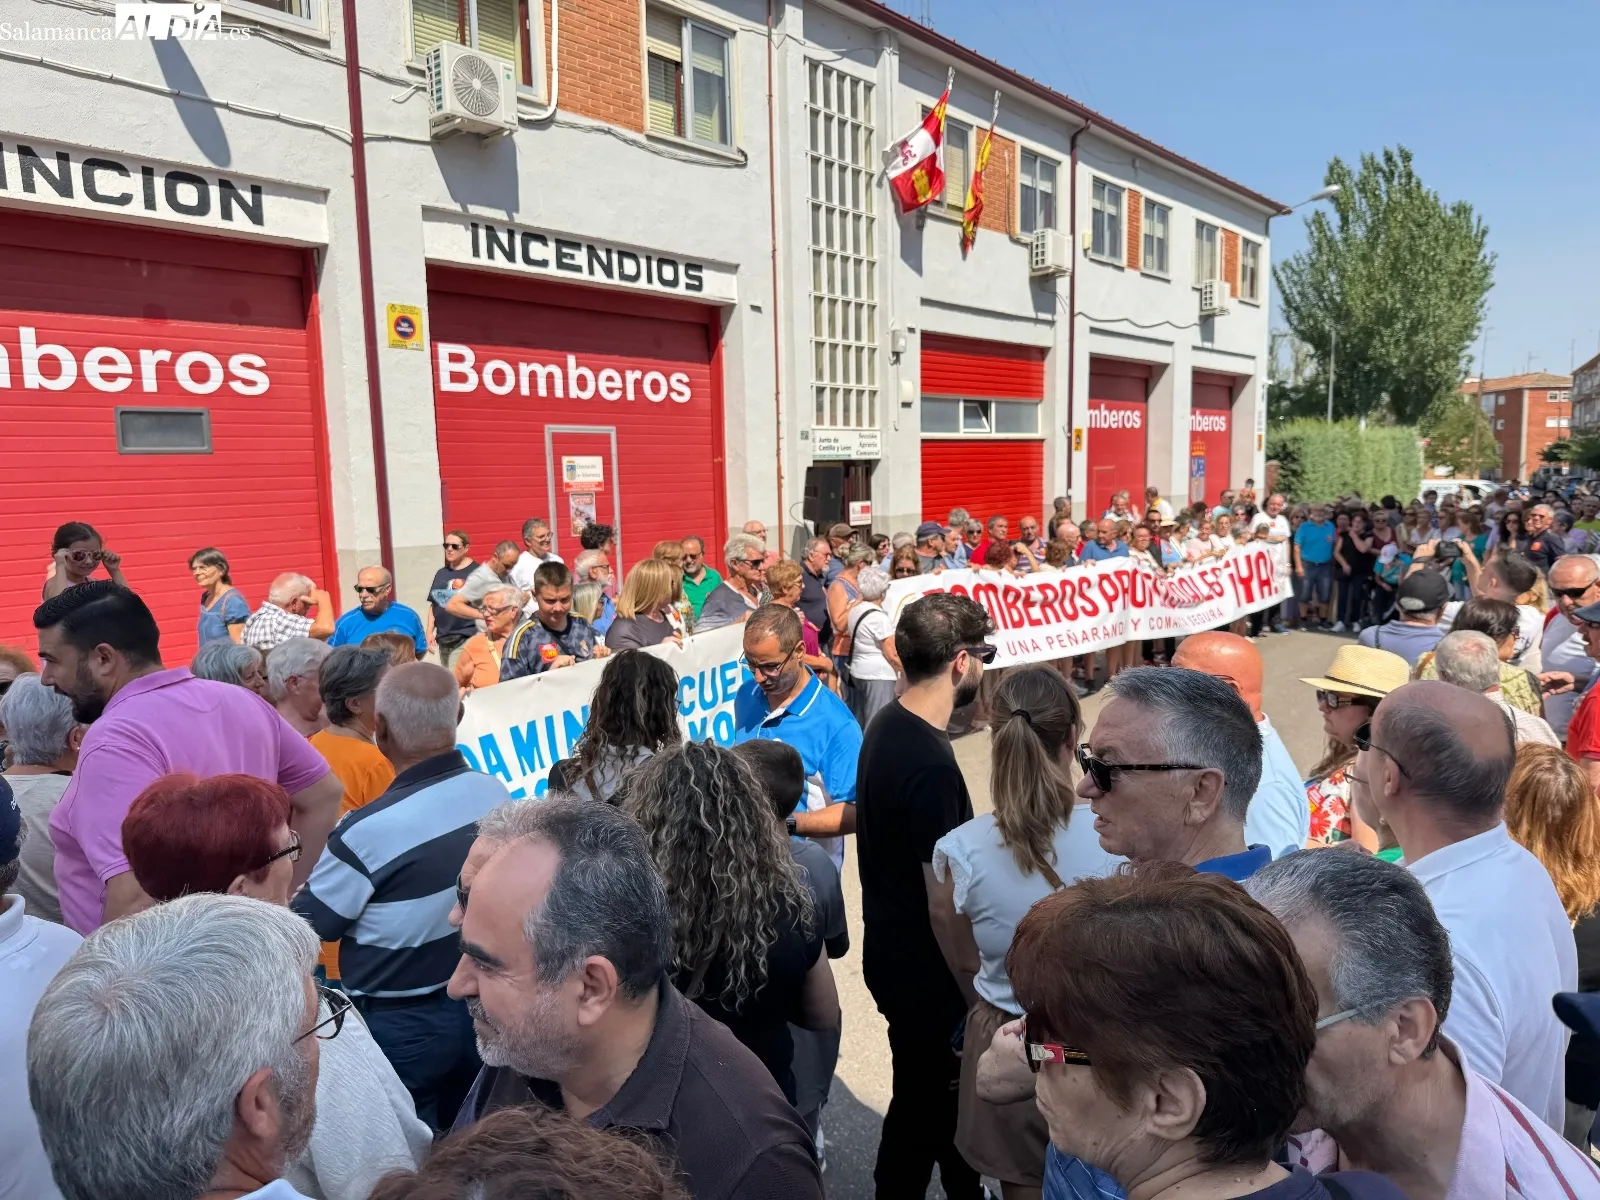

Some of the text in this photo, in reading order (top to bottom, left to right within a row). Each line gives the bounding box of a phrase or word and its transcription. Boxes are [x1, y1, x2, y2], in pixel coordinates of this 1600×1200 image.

[470, 222, 704, 293] INCENDIOS
[0, 326, 270, 396] beros
[436, 342, 693, 403] Bomberos
[922, 576, 1099, 630] MBEROS
[1006, 639, 1042, 656] UNA
[1046, 621, 1125, 650] PEÑARAND
[1131, 618, 1141, 632] Y
